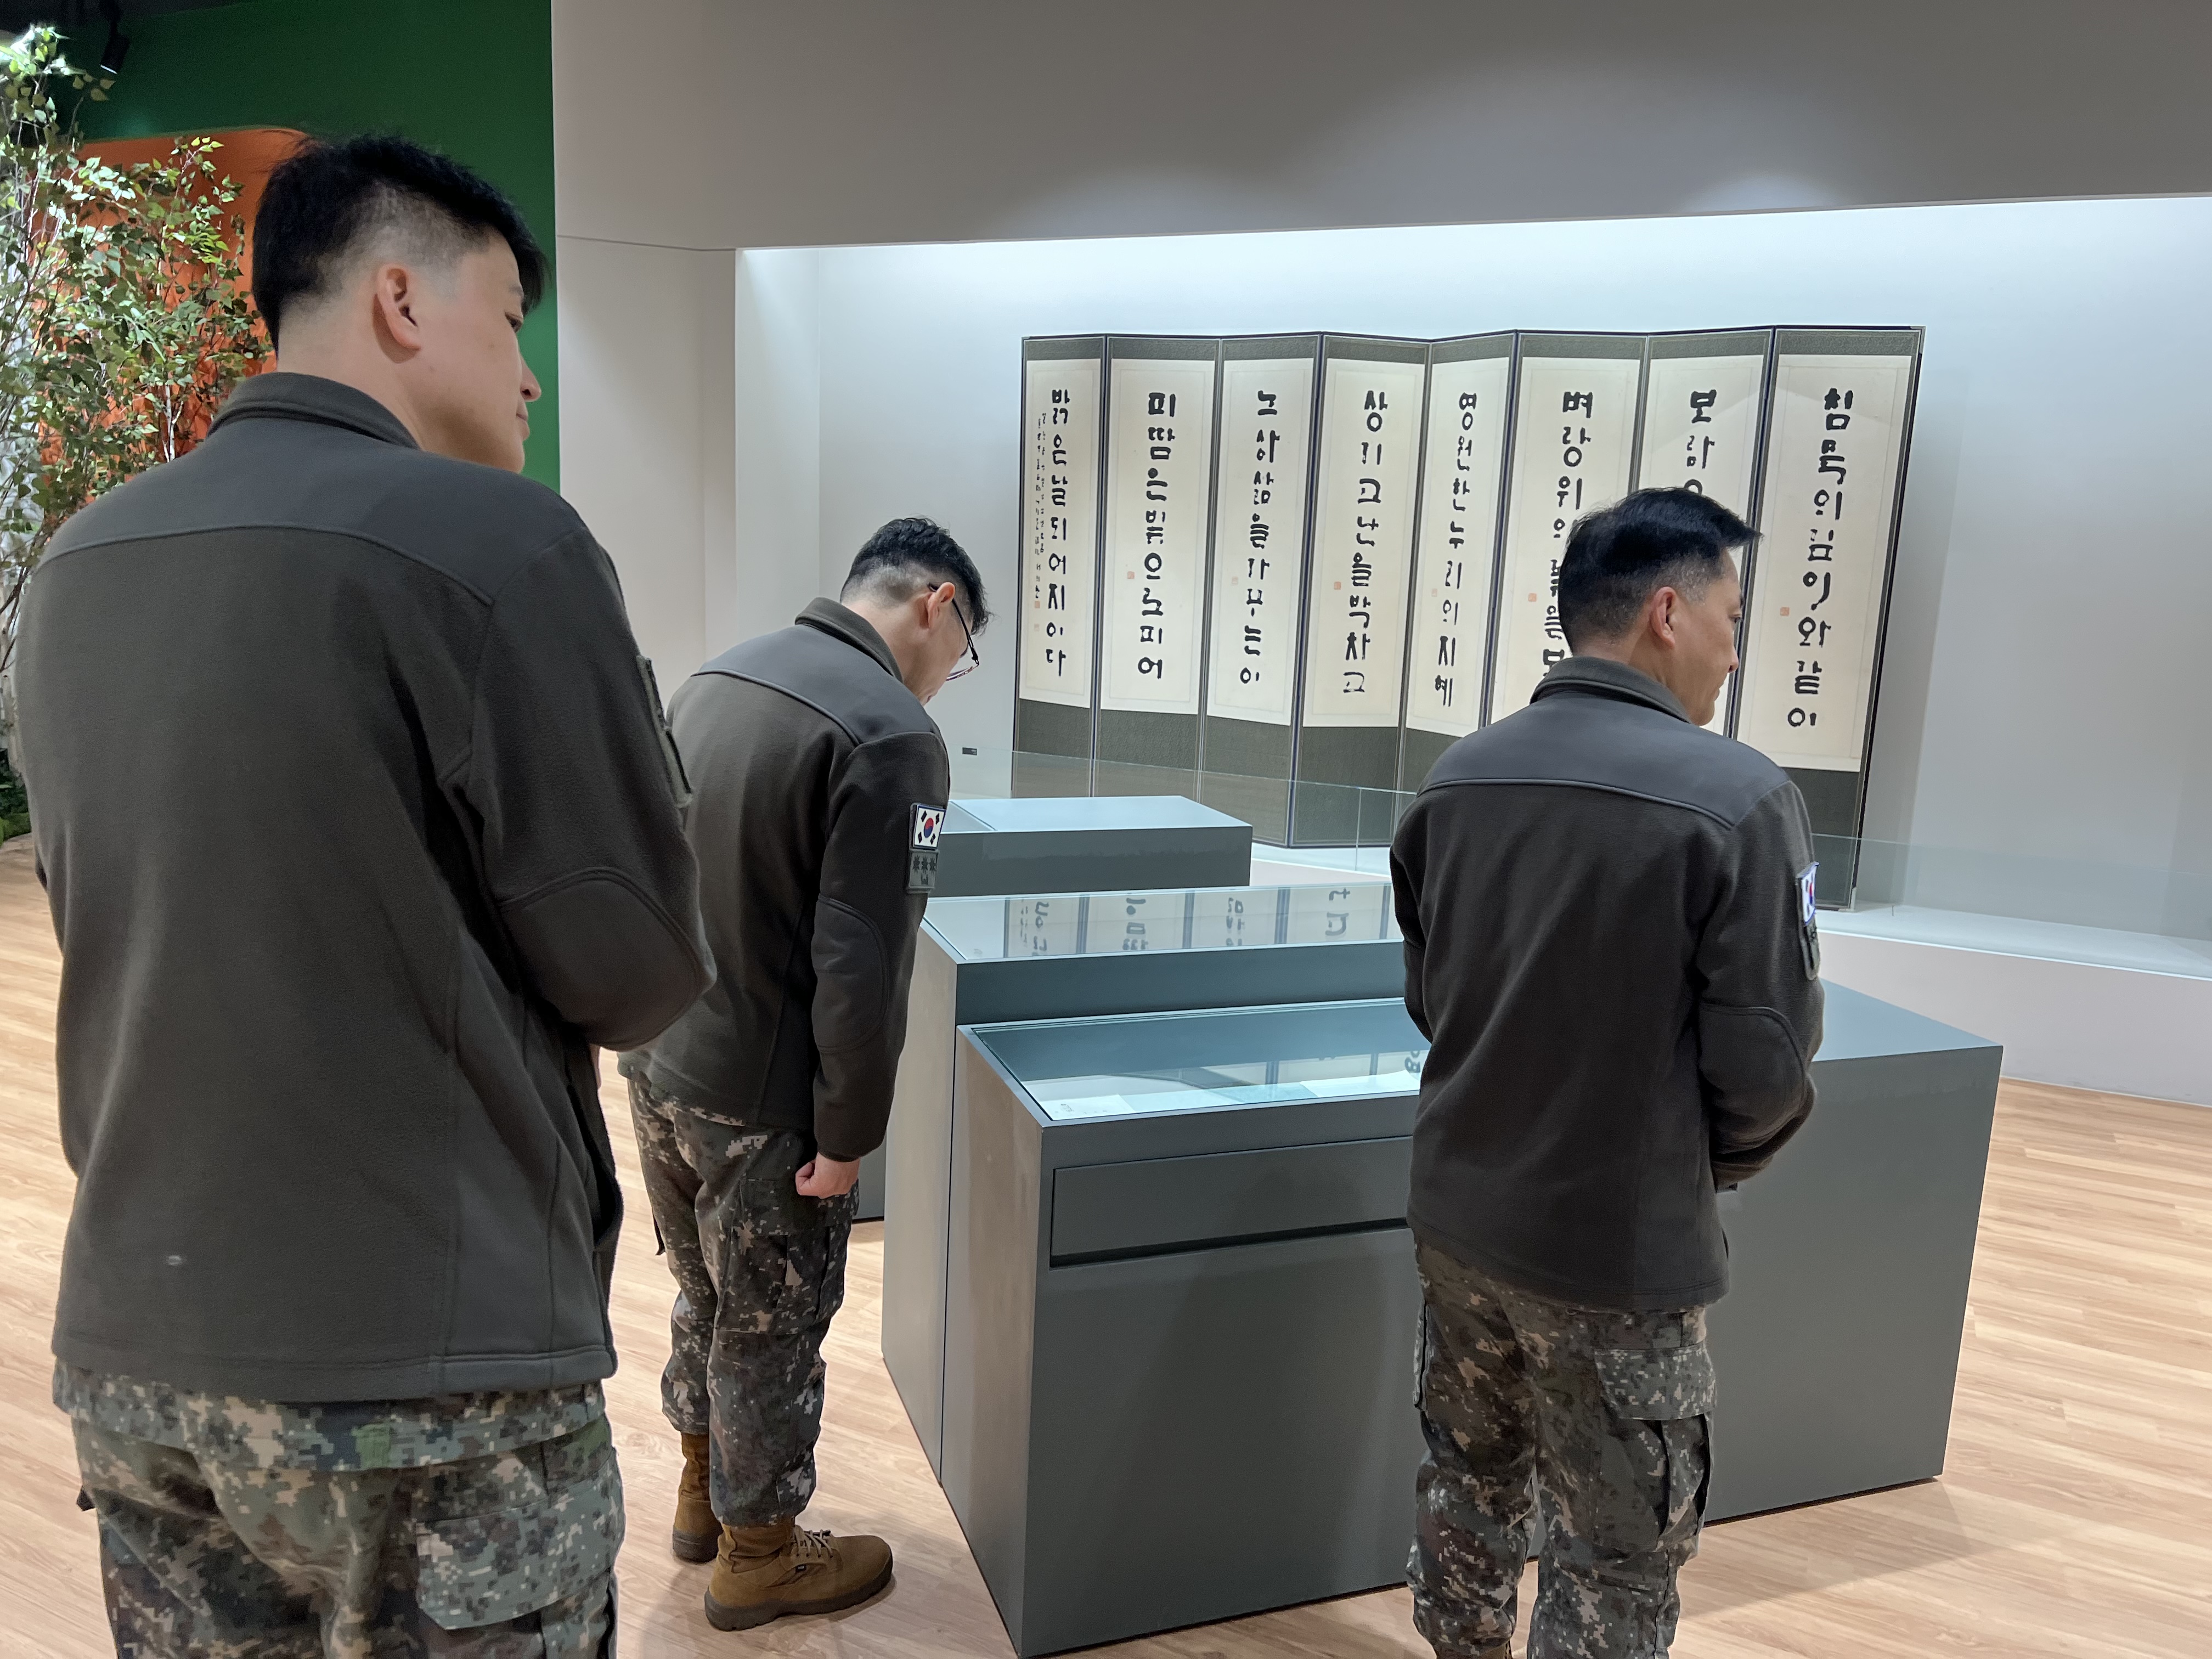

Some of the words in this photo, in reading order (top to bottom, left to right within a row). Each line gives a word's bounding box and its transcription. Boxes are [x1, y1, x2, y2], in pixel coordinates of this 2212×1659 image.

[1052, 389, 1070, 466] 밝은
[1361, 390, 1388, 465] 상기
[1453, 393, 1477, 512] 영원한
[1562, 391, 1593, 467] 벼랑
[1814, 388, 1853, 520] 침묵의
[1051, 475, 1068, 507] 날
[1250, 471, 1274, 549] 삶을
[1351, 478, 1381, 587] 고난을
[1244, 558, 1270, 656] 가꾸는
[1443, 521, 1464, 625] 누리의
[1798, 529, 1834, 648] 깊이와
[1240, 667, 1260, 684] 이
[1343, 595, 1371, 693] 박차고
[1435, 635, 1455, 707] 지혜
[1787, 661, 1822, 727] 같이
